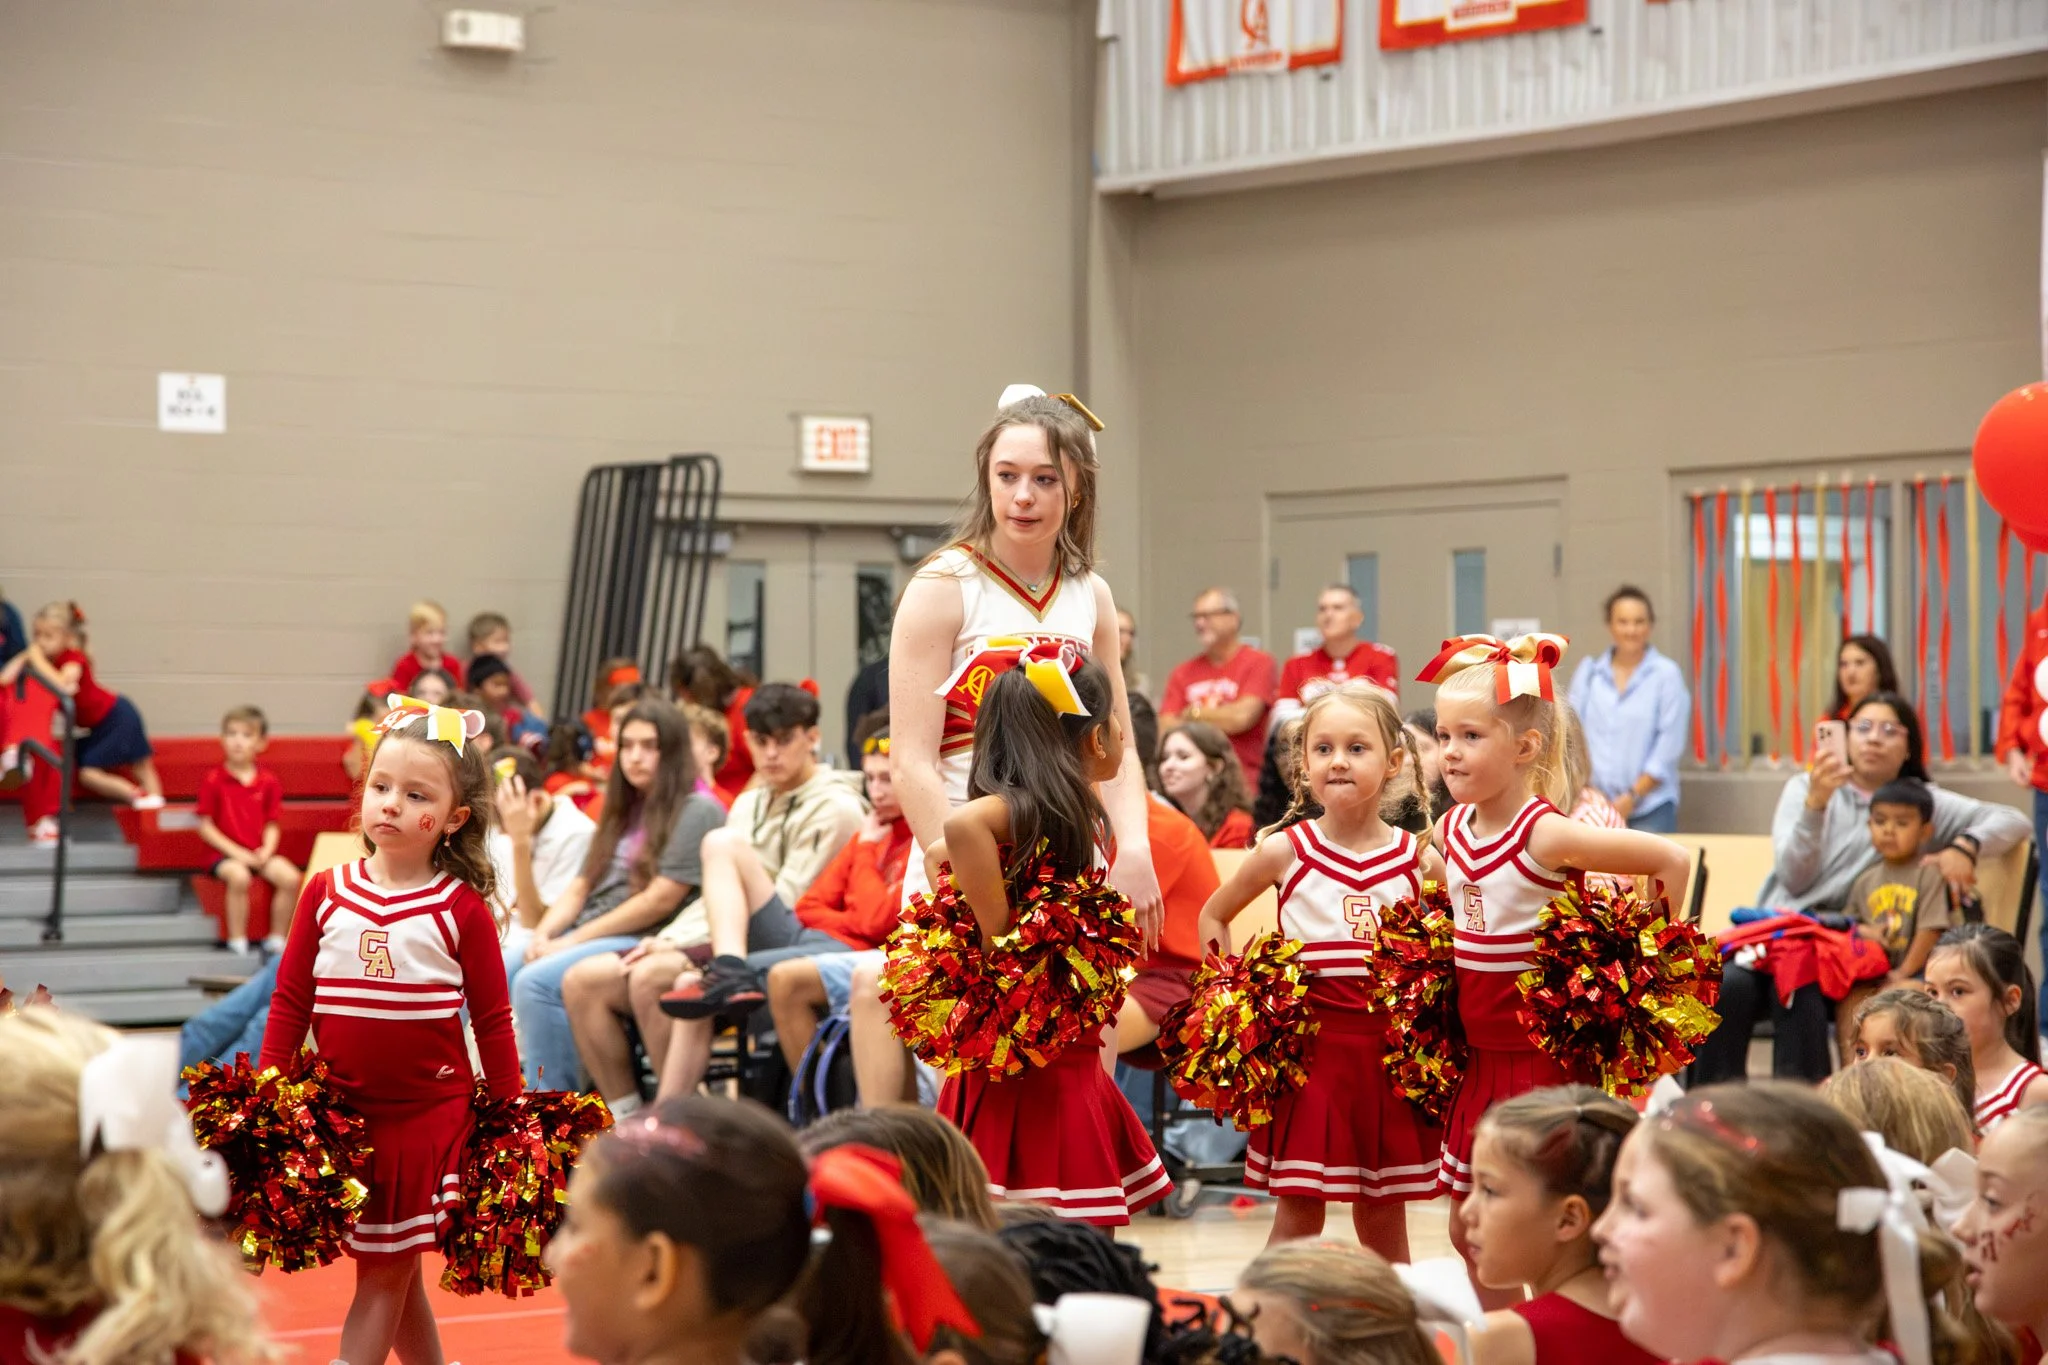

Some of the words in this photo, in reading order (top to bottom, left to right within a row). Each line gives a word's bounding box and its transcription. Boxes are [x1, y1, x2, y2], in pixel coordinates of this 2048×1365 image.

[1343, 894, 1381, 941] CA
[1463, 884, 1486, 932] CA
[358, 929, 396, 979] CA
